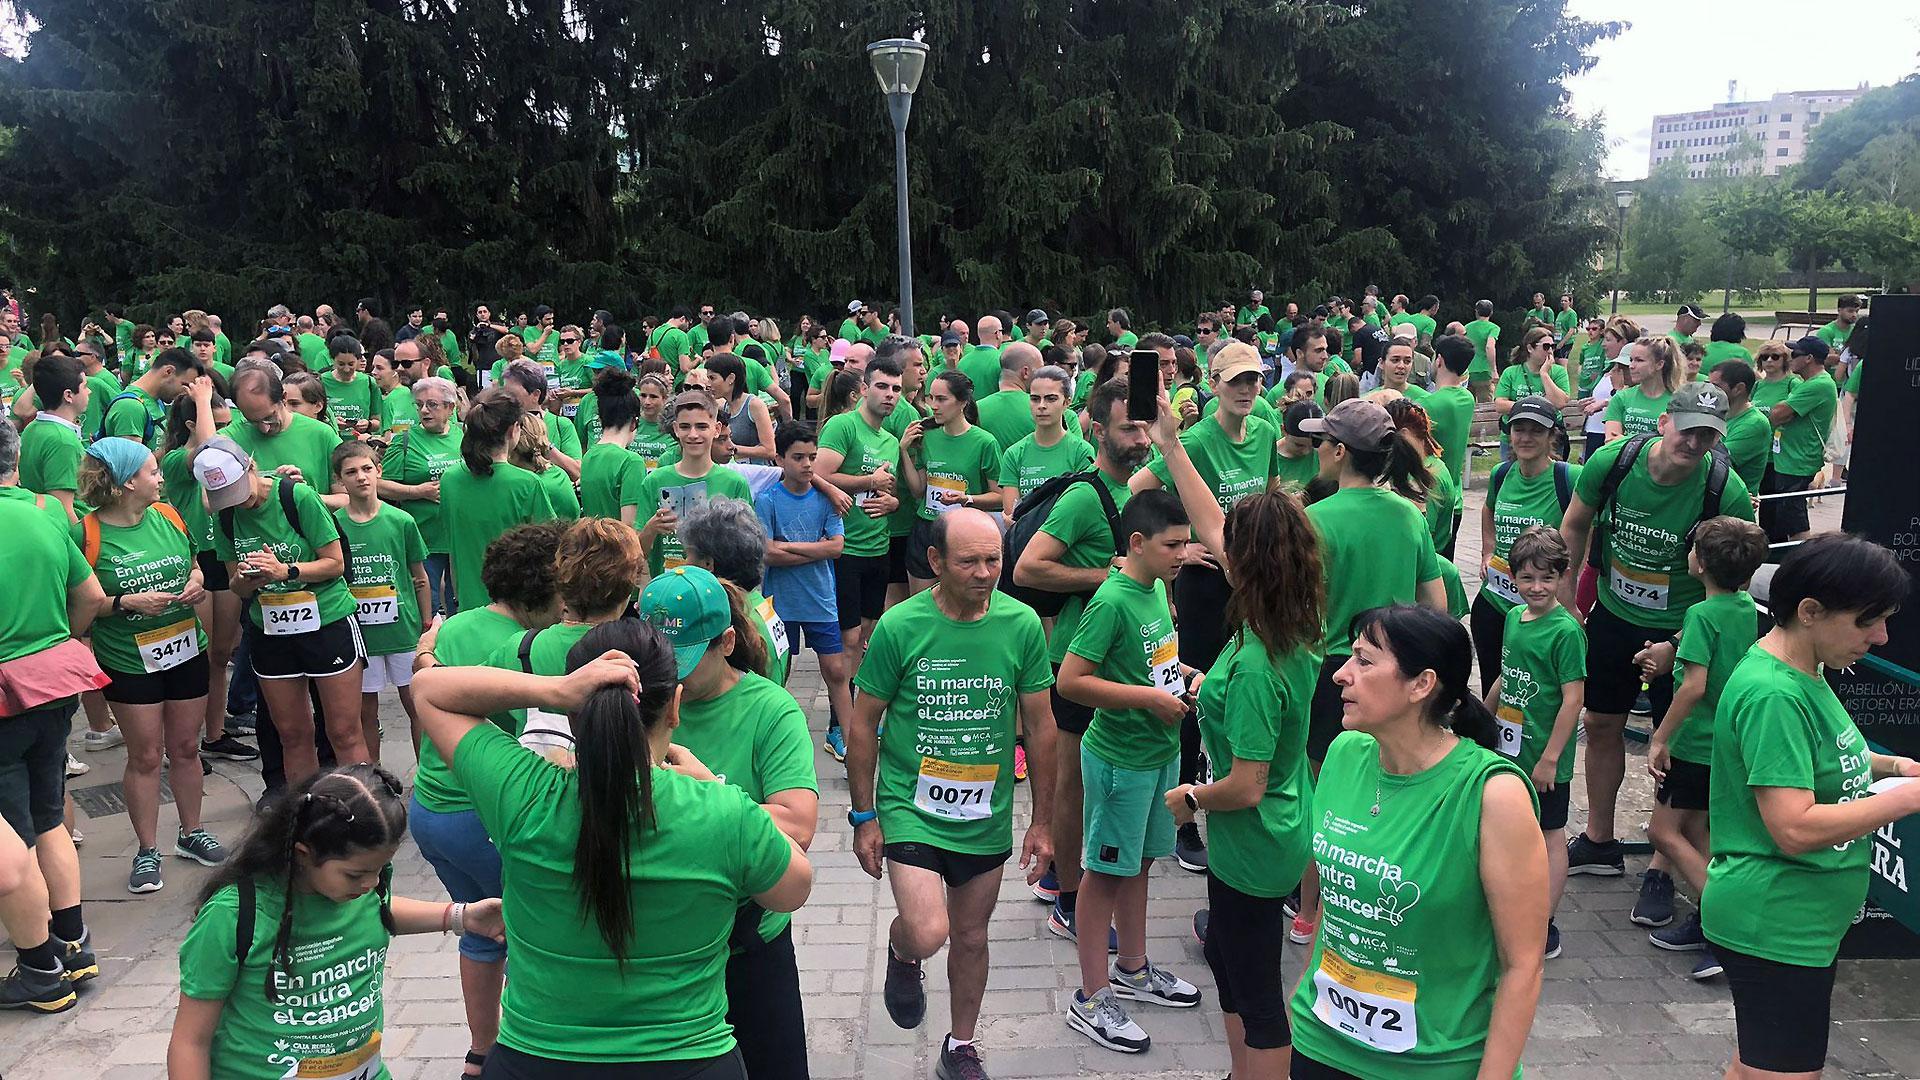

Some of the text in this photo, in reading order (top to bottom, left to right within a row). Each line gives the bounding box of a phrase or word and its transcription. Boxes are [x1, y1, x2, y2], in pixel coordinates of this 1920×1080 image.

[1219, 483, 1233, 493] En
[1502, 514, 1544, 526] marcha
[1625, 520, 1678, 543] marcha
[115, 567, 135, 578] En
[136, 555, 183, 573] marcha
[120, 571, 164, 589] contra
[1616, 578, 1660, 601] 1574
[269, 607, 313, 624] 3472
[151, 635, 192, 661] 3471
[917, 674, 1003, 690] En marcha
[1838, 681, 1904, 696] PABELLÓN
[916, 691, 969, 706] contra
[934, 706, 989, 721] cáncer
[1838, 754, 1861, 773] En
[928, 784, 984, 806] 0071
[1313, 831, 1402, 882] En marcha
[1323, 886, 1384, 921] cáncer
[1361, 936, 1389, 950] MCA
[273, 946, 388, 990] En marcha
[274, 981, 353, 1008] contra
[301, 991, 377, 1026] cáncer
[1327, 986, 1403, 1032] 0072
